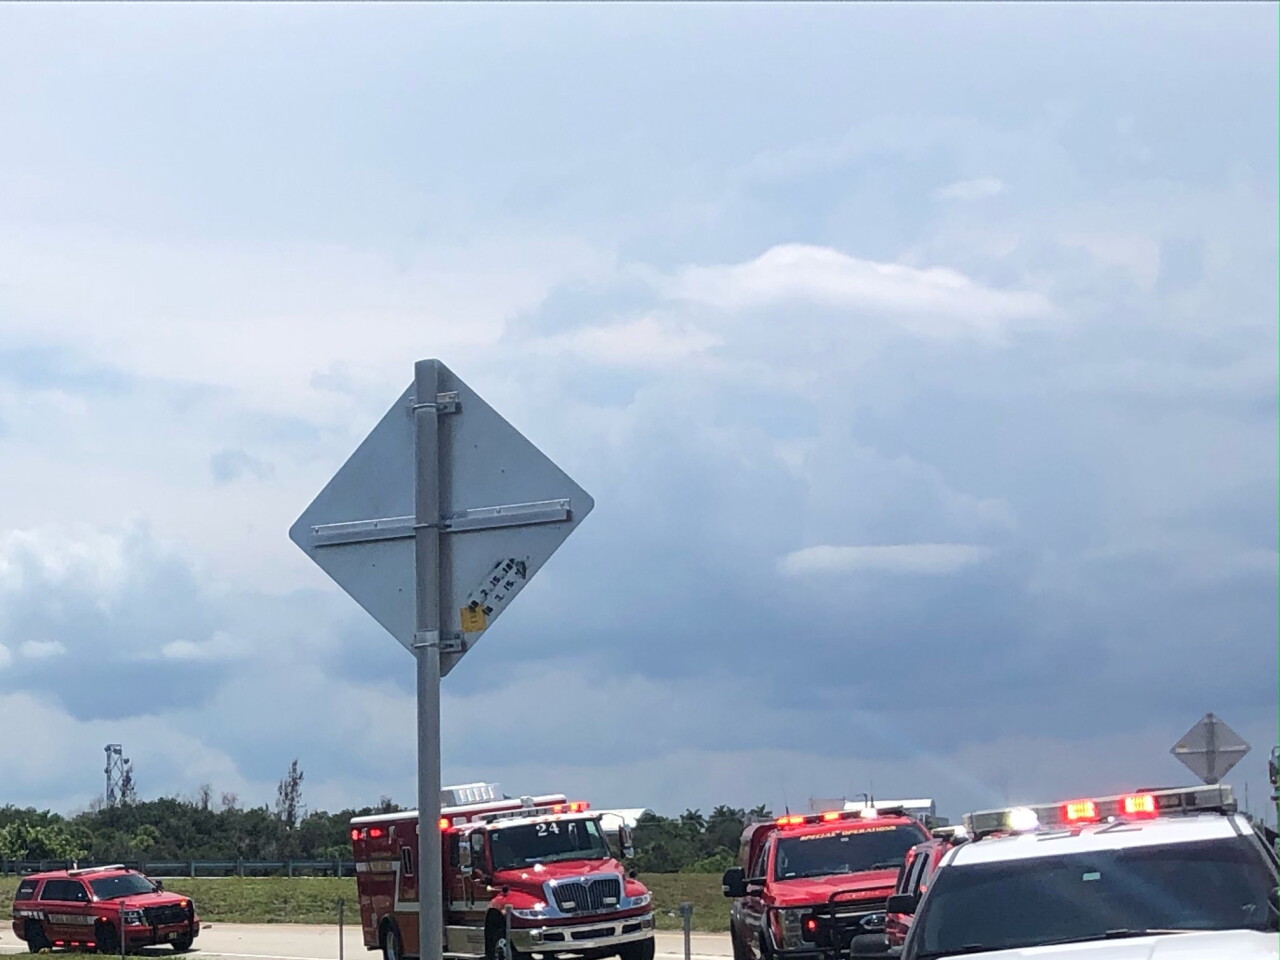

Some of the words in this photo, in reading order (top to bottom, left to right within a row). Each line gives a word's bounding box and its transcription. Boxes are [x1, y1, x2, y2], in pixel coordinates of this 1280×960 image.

[535, 822, 560, 837] 24
[800, 831, 836, 841] SPECIAL
[841, 825, 896, 836] OPERATIONS
